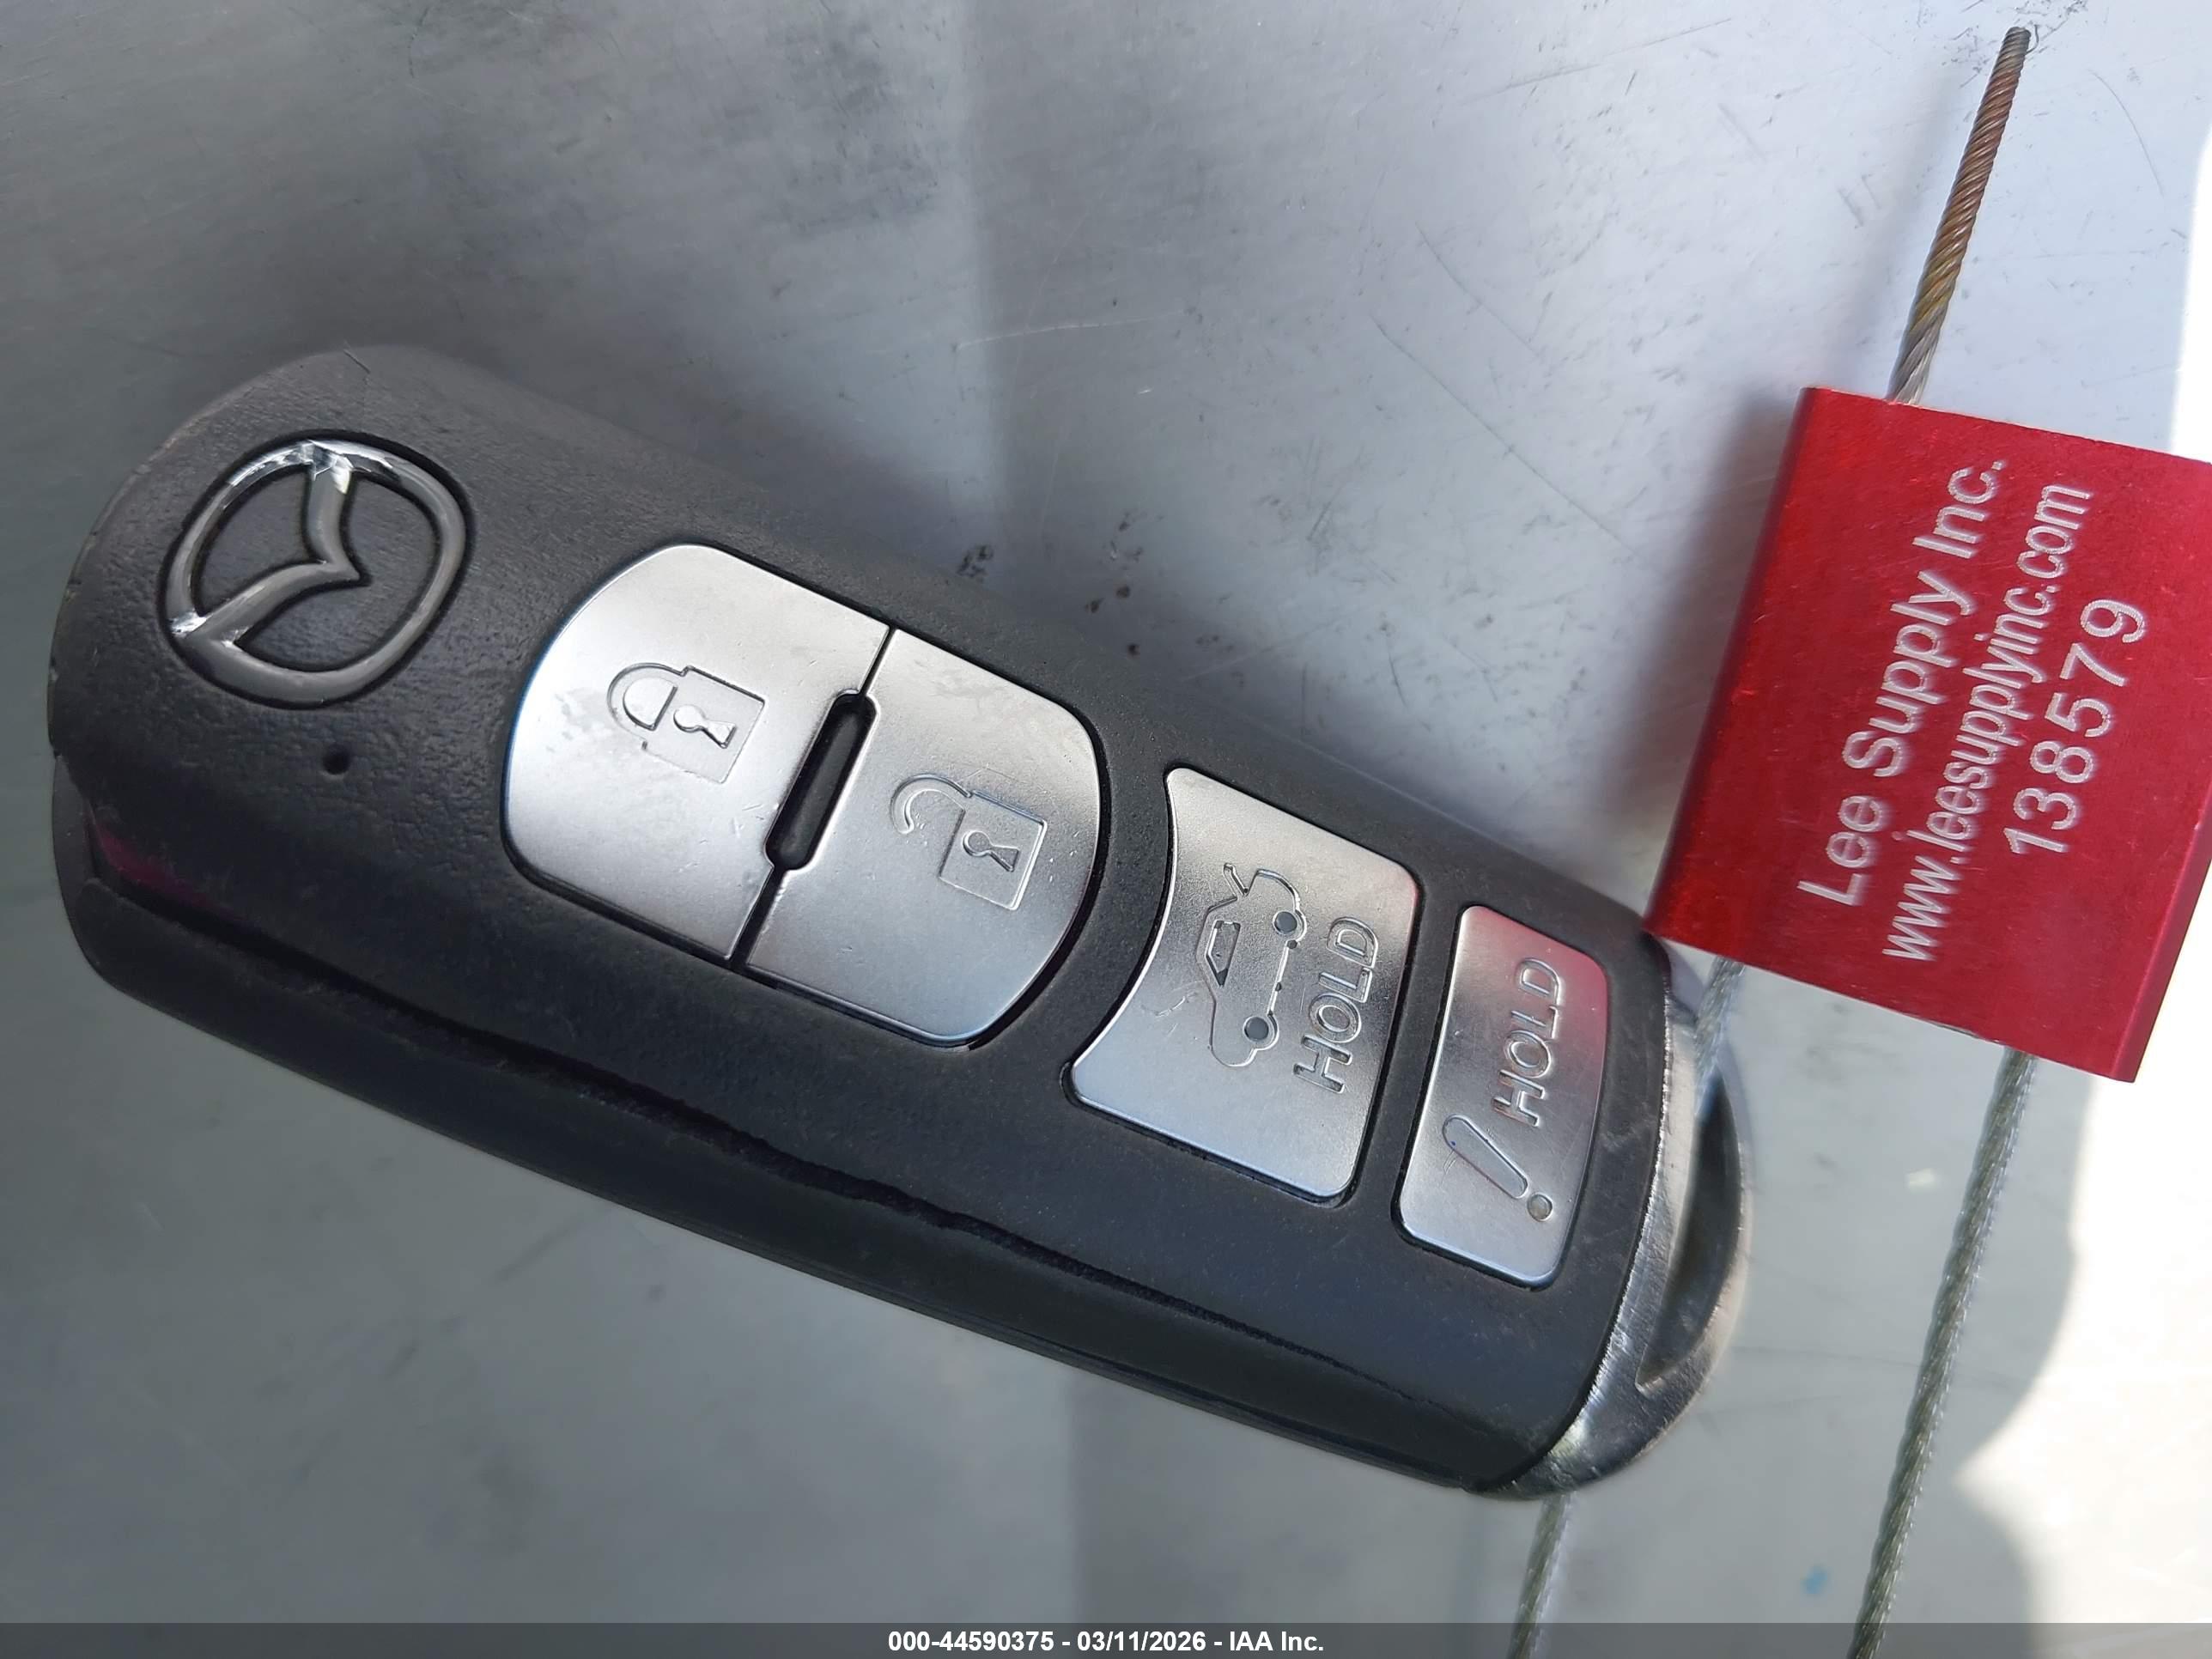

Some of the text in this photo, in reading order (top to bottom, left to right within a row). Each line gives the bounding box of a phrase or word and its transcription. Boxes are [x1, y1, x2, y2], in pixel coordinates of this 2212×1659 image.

[1797, 459, 2008, 908] Lee Supply Inc.
[1882, 483, 2091, 963] www.leesupplyinc.com
[2010, 598, 2147, 855] 138579
[1292, 915, 1380, 1094] HOLD
[1492, 957, 1564, 1128] HOLD
